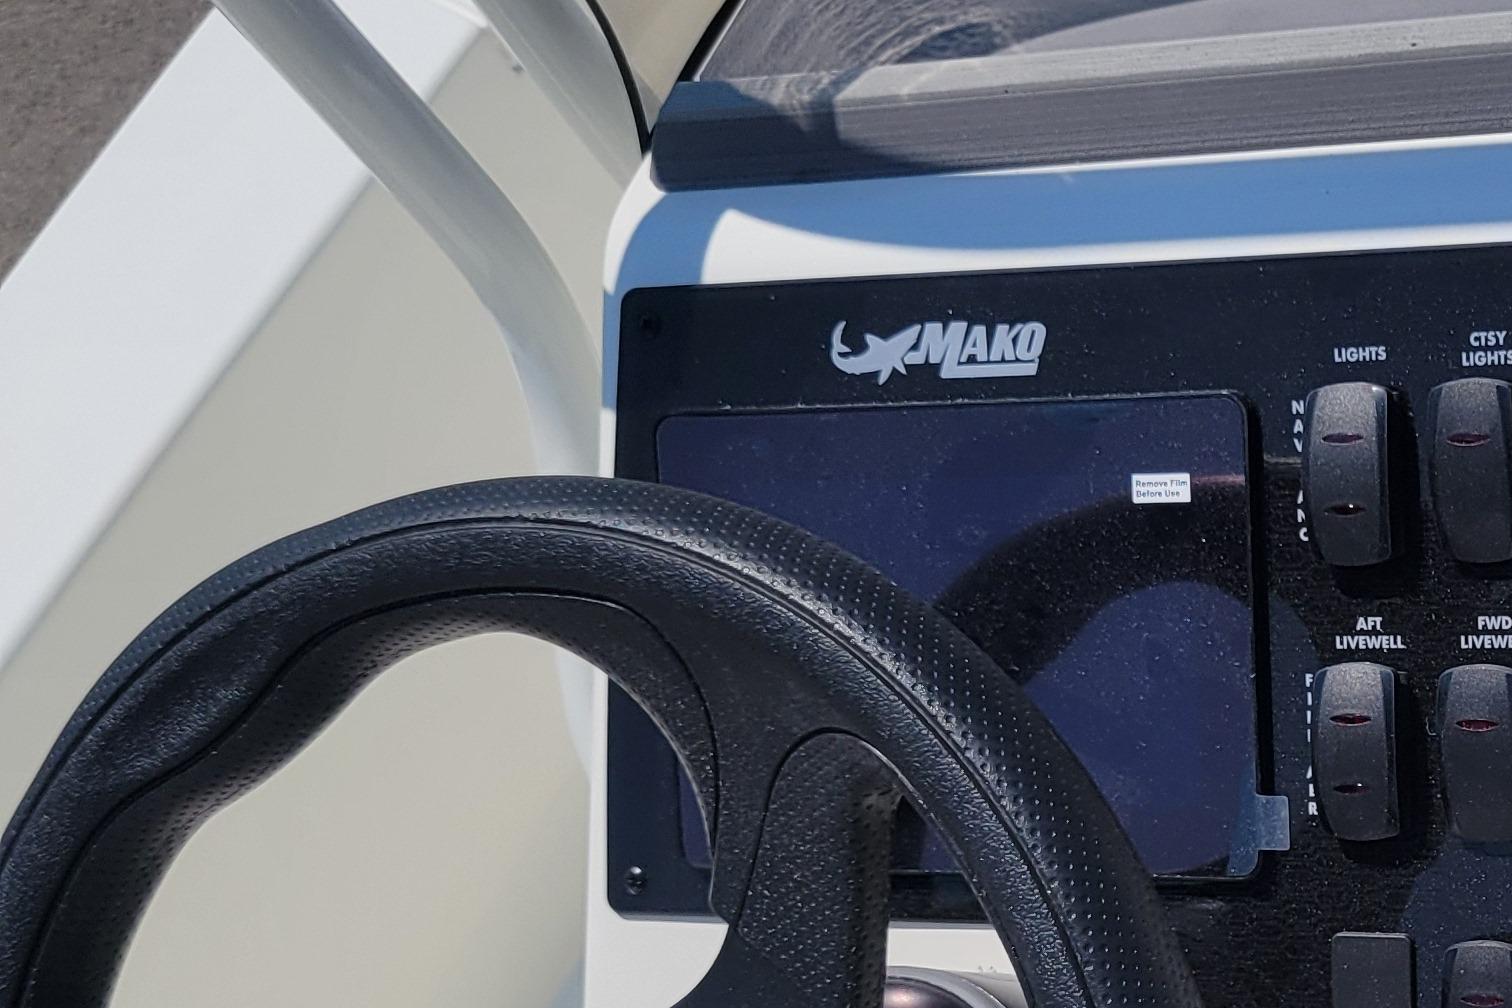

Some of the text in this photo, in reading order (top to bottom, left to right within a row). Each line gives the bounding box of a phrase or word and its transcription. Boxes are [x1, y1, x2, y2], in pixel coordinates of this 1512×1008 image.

[1469, 331, 1507, 347] CTSY
[903, 321, 1047, 379] MAKO
[1333, 346, 1387, 362] LIGHTS
[1136, 479, 1188, 488] Remove Film
[1136, 490, 1180, 498] Before Use
[1356, 617, 1382, 630] AFT
[1477, 616, 1512, 630] FWD
[1335, 635, 1405, 649] LIVEWELL
